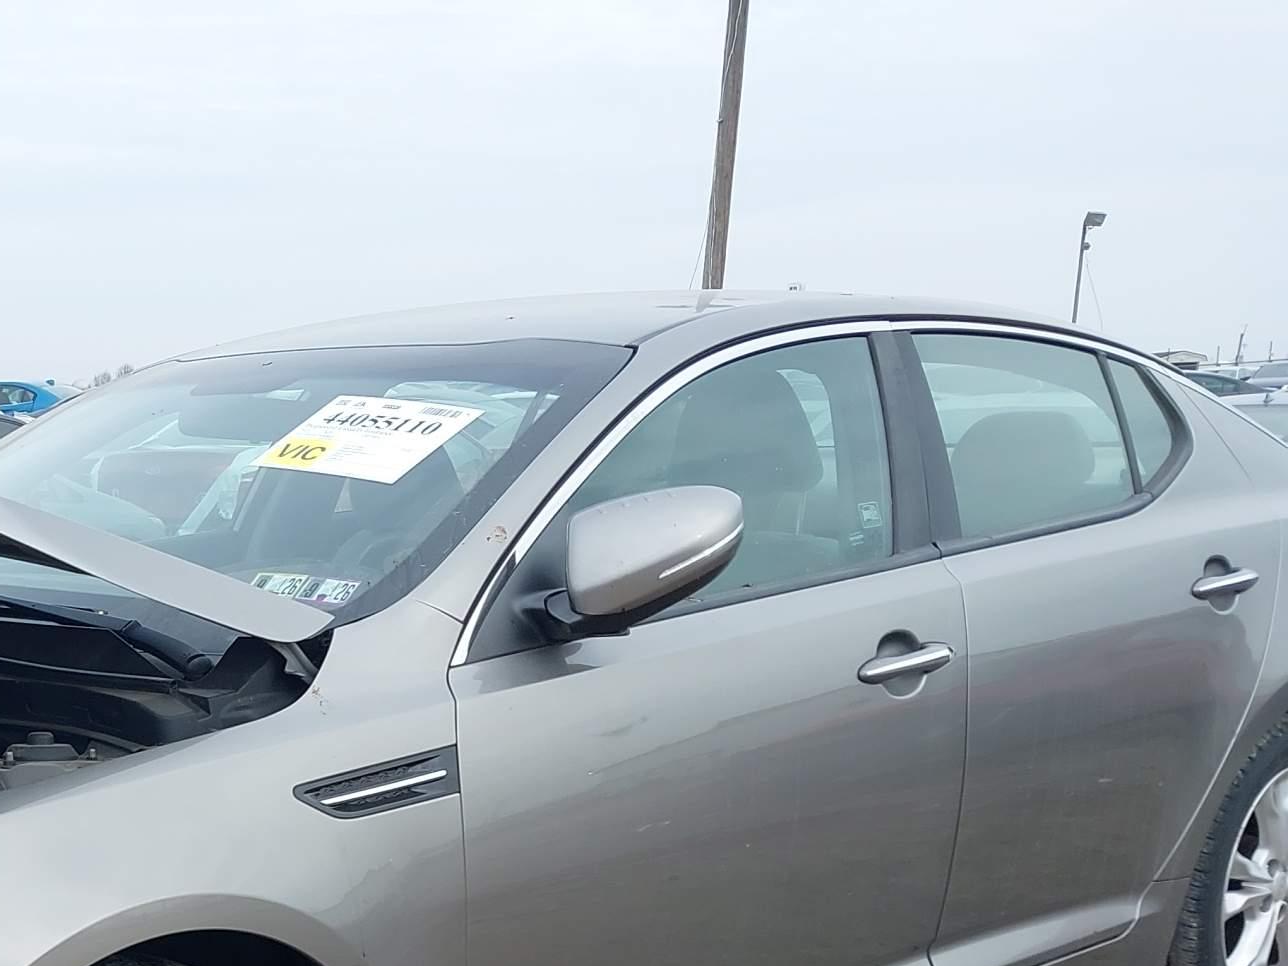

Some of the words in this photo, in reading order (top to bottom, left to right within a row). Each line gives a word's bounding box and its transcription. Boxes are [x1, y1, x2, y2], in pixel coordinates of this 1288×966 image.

[322, 410, 443, 436] 44055110
[277, 442, 327, 461] VIC
[281, 577, 303, 596] 26
[333, 583, 356, 601] 26
